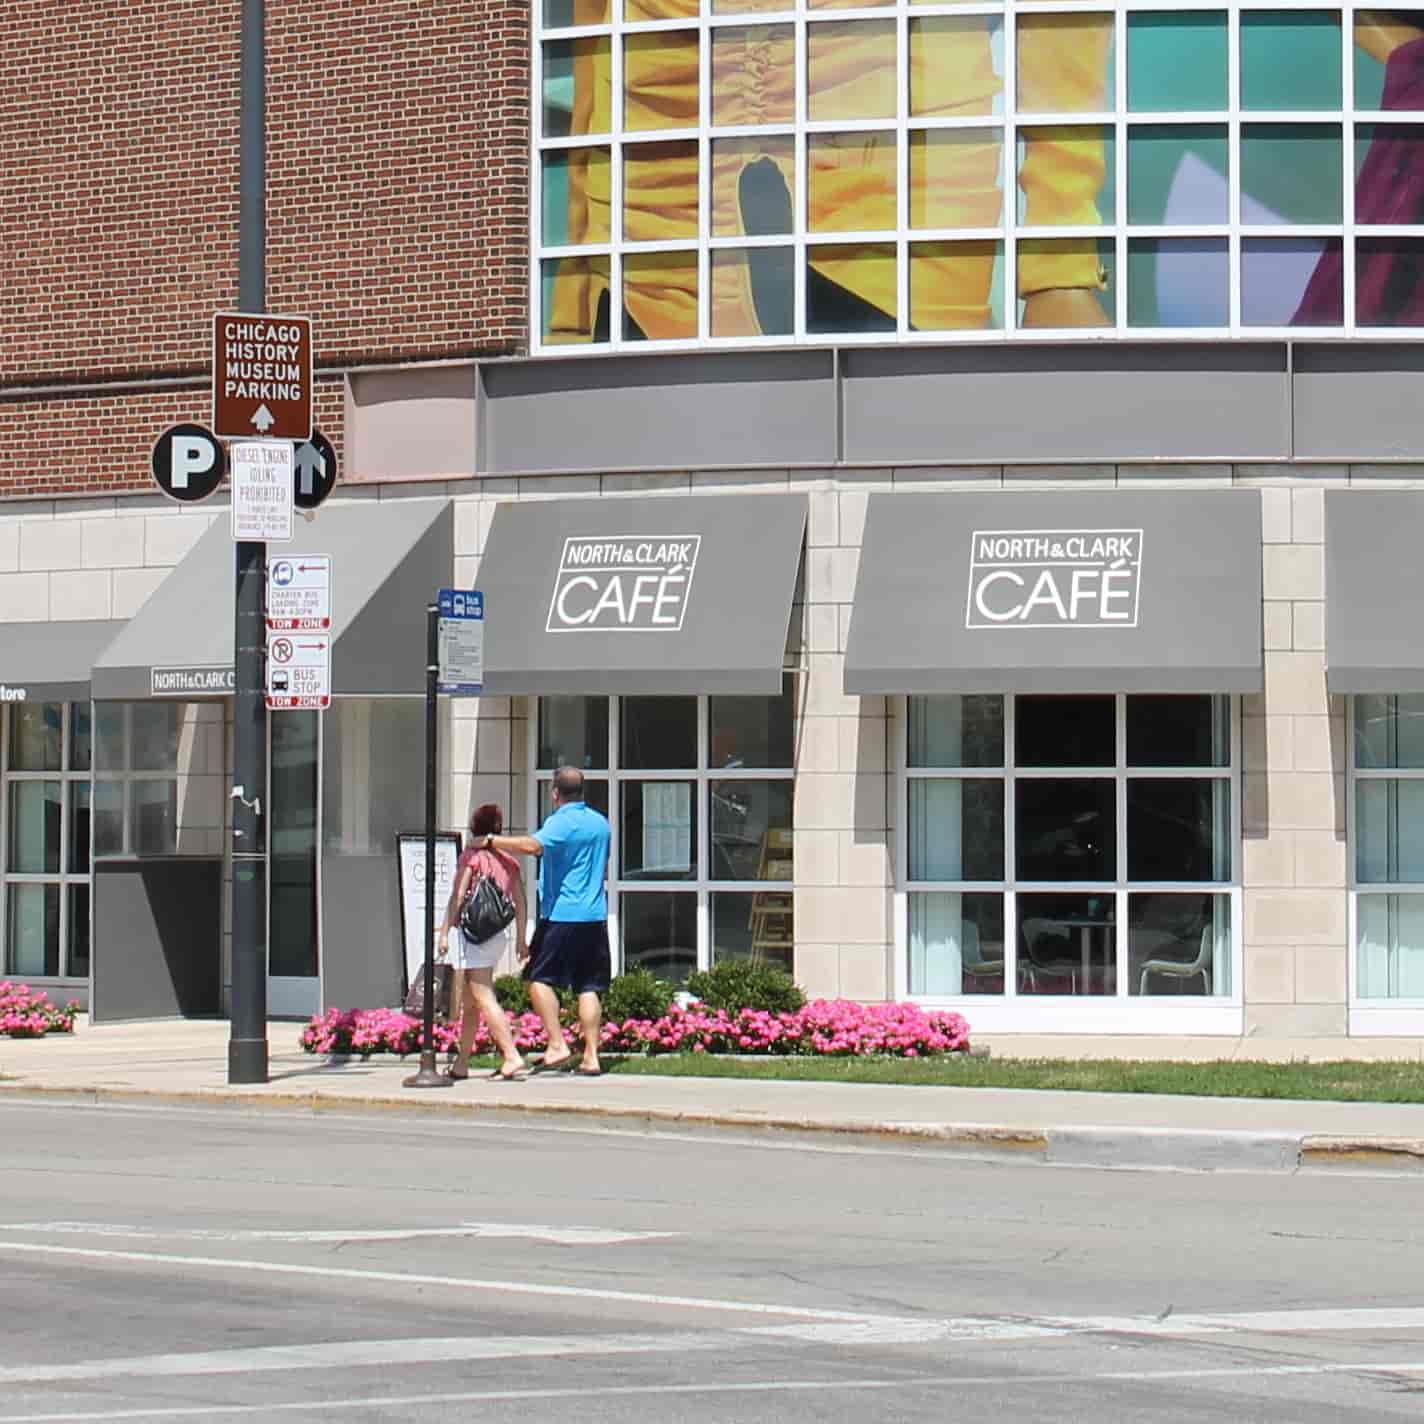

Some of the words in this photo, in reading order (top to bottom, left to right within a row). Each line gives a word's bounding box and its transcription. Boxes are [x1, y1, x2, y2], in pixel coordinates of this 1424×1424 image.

[225, 323, 300, 342] CHICAGO
[225, 342, 299, 361] HISTORY
[226, 362, 300, 381] MUSEUM
[225, 381, 301, 400] PARKING
[171, 436, 215, 488] P
[557, 563, 686, 624] CAFÉ
[976, 558, 1132, 620] CAFÉ
[272, 619, 292, 629] TOW
[299, 618, 321, 629] ZONE
[293, 669, 315, 680] BUS
[293, 681, 320, 693] STOP
[272, 696, 291, 706] TOW
[298, 696, 320, 706] ZONE
